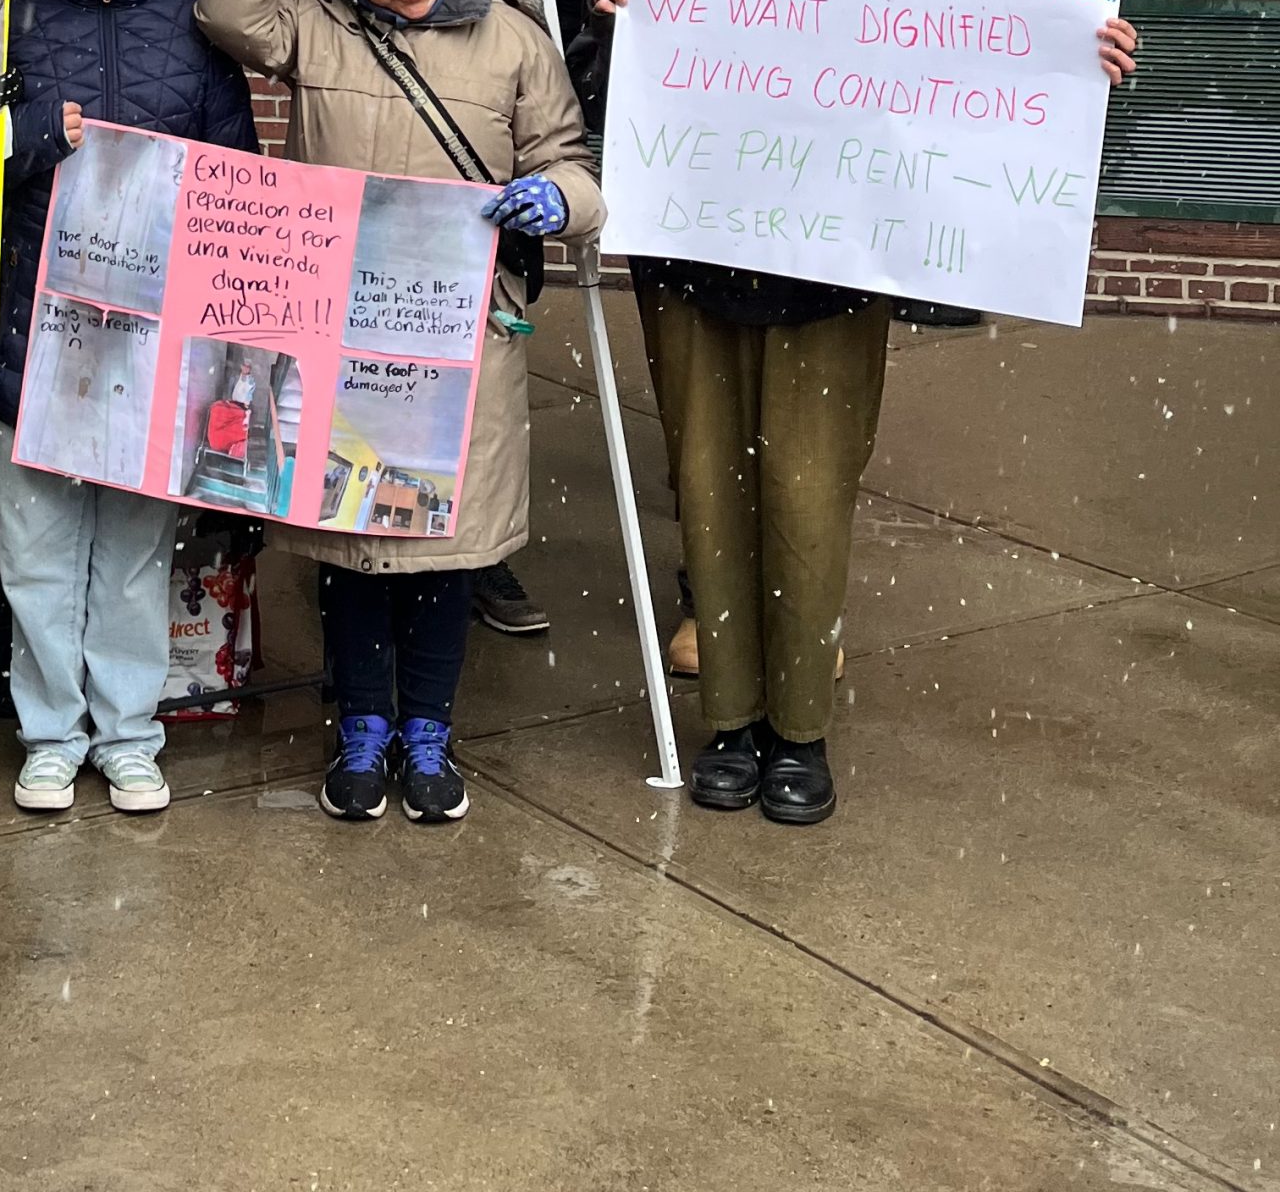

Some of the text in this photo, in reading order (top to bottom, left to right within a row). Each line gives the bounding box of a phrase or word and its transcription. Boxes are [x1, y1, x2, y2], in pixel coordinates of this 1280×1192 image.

[628, 117, 719, 171] WE
[736, 129, 814, 189] PAY
[195, 154, 278, 195] Exijo la
[186, 190, 333, 223] reparacion del
[657, 194, 844, 243] DESERVE
[57, 230, 158, 264] The door is in
[187, 216, 270, 236] elevador
[275, 227, 291, 253] y
[58, 246, 147, 273] bad condition
[188, 240, 321, 279] una vivienda
[357, 269, 397, 290] This
[433, 281, 460, 294] the
[42, 303, 149, 346] This is really
[349, 316, 461, 334] bad condition
[377, 305, 391, 317] in
[396, 307, 442, 326] really
[349, 360, 380, 376] The
[423, 365, 439, 380] is
